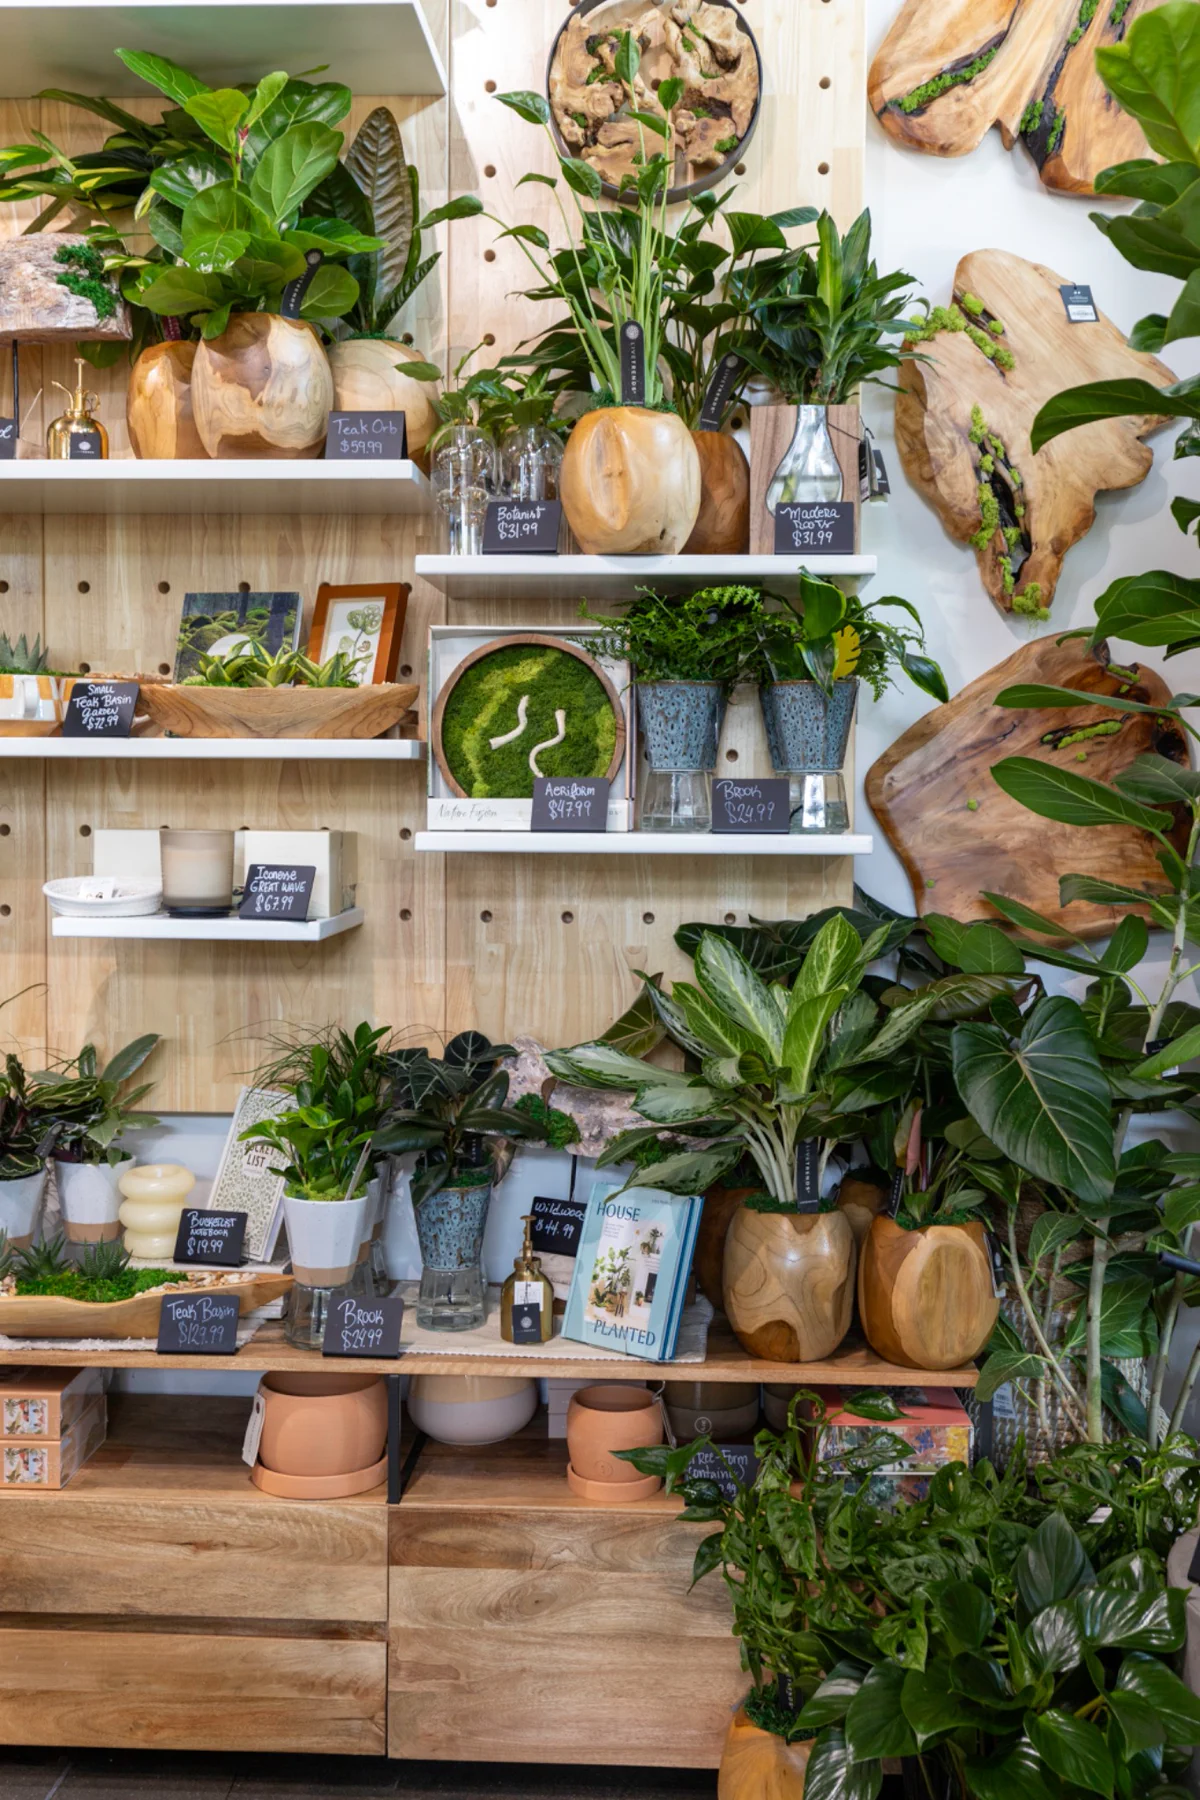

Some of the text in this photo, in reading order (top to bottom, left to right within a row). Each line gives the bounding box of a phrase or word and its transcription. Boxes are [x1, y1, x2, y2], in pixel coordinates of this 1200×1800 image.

[332, 418, 398, 435] Teak Orb
[340, 438, 383, 454] $59.99
[497, 505, 546, 521] Botanist
[497, 520, 538, 540] $31.99
[792, 530, 833, 547] $31.99
[87, 715, 119, 730] $72.99
[548, 800, 592, 820] $47.99
[724, 801, 775, 823] $24.99
[249, 881, 306, 893] GREAT WAVE
[255, 893, 294, 912] $67.99
[246, 1154, 266, 1167] LIST
[596, 1202, 641, 1222] HOUSE
[187, 1237, 224, 1256] $19.99
[166, 1297, 235, 1323] Teak Basin
[178, 1320, 225, 1347] $129.99
[341, 1328, 383, 1351] $24.99
[593, 1319, 656, 1347] PLANTED
